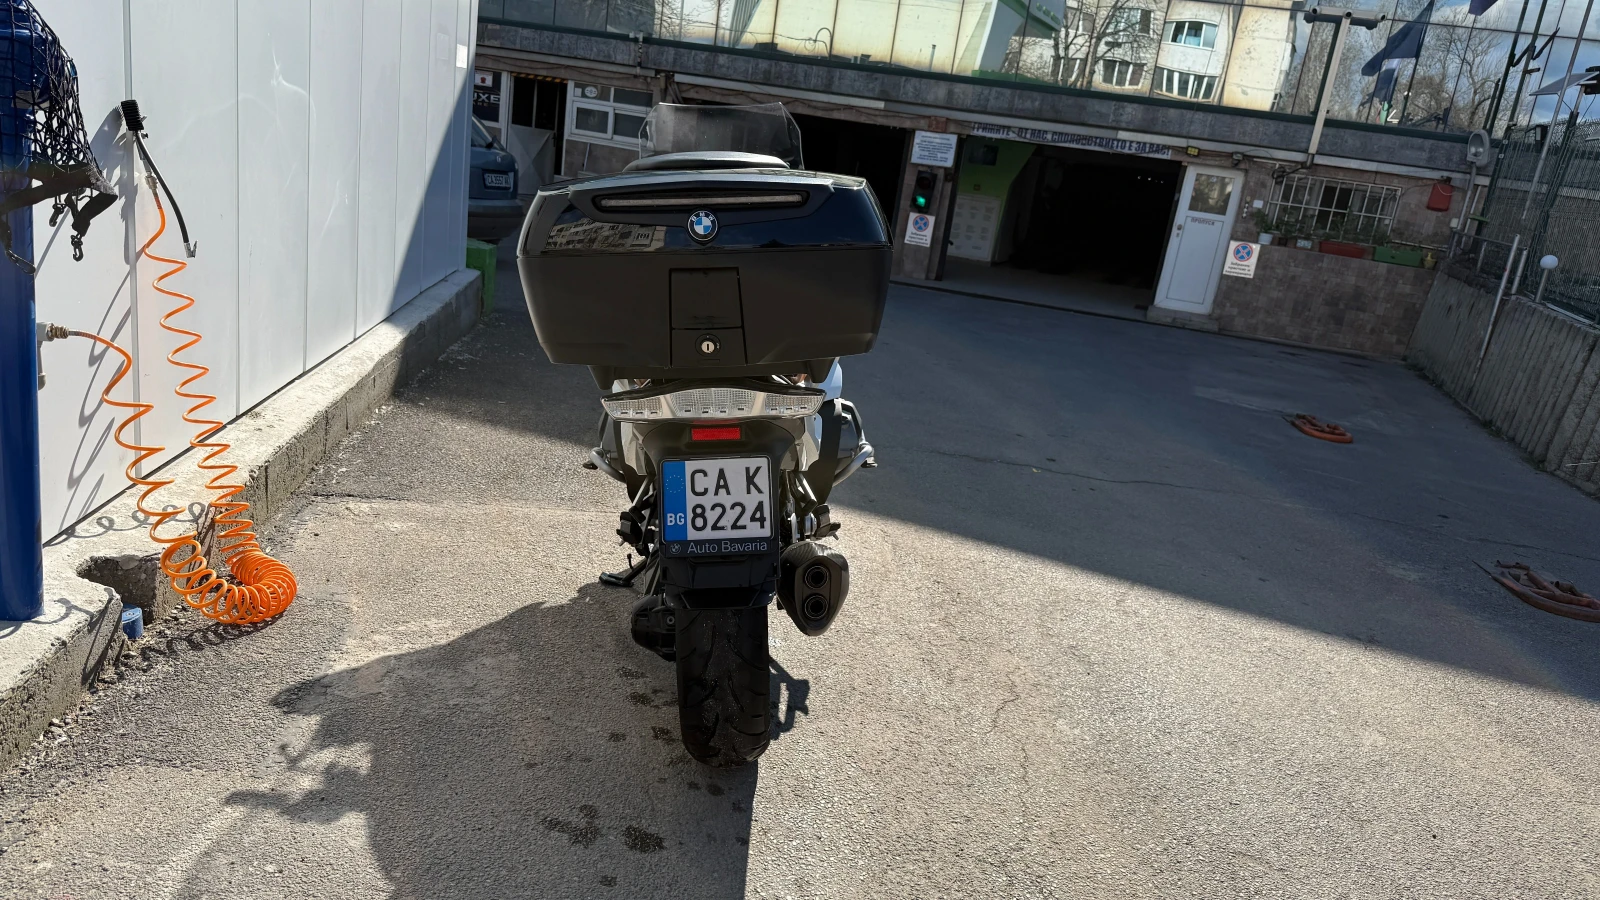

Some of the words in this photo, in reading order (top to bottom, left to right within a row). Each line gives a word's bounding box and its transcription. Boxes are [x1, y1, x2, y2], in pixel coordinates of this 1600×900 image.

[1135, 140, 1147, 153] ЗА
[690, 468, 731, 497] CA
[745, 465, 765, 495] K
[666, 512, 685, 526] BG
[690, 500, 767, 532] 8224
[687, 542, 718, 554] Auto
[721, 539, 768, 553] Bavaria
